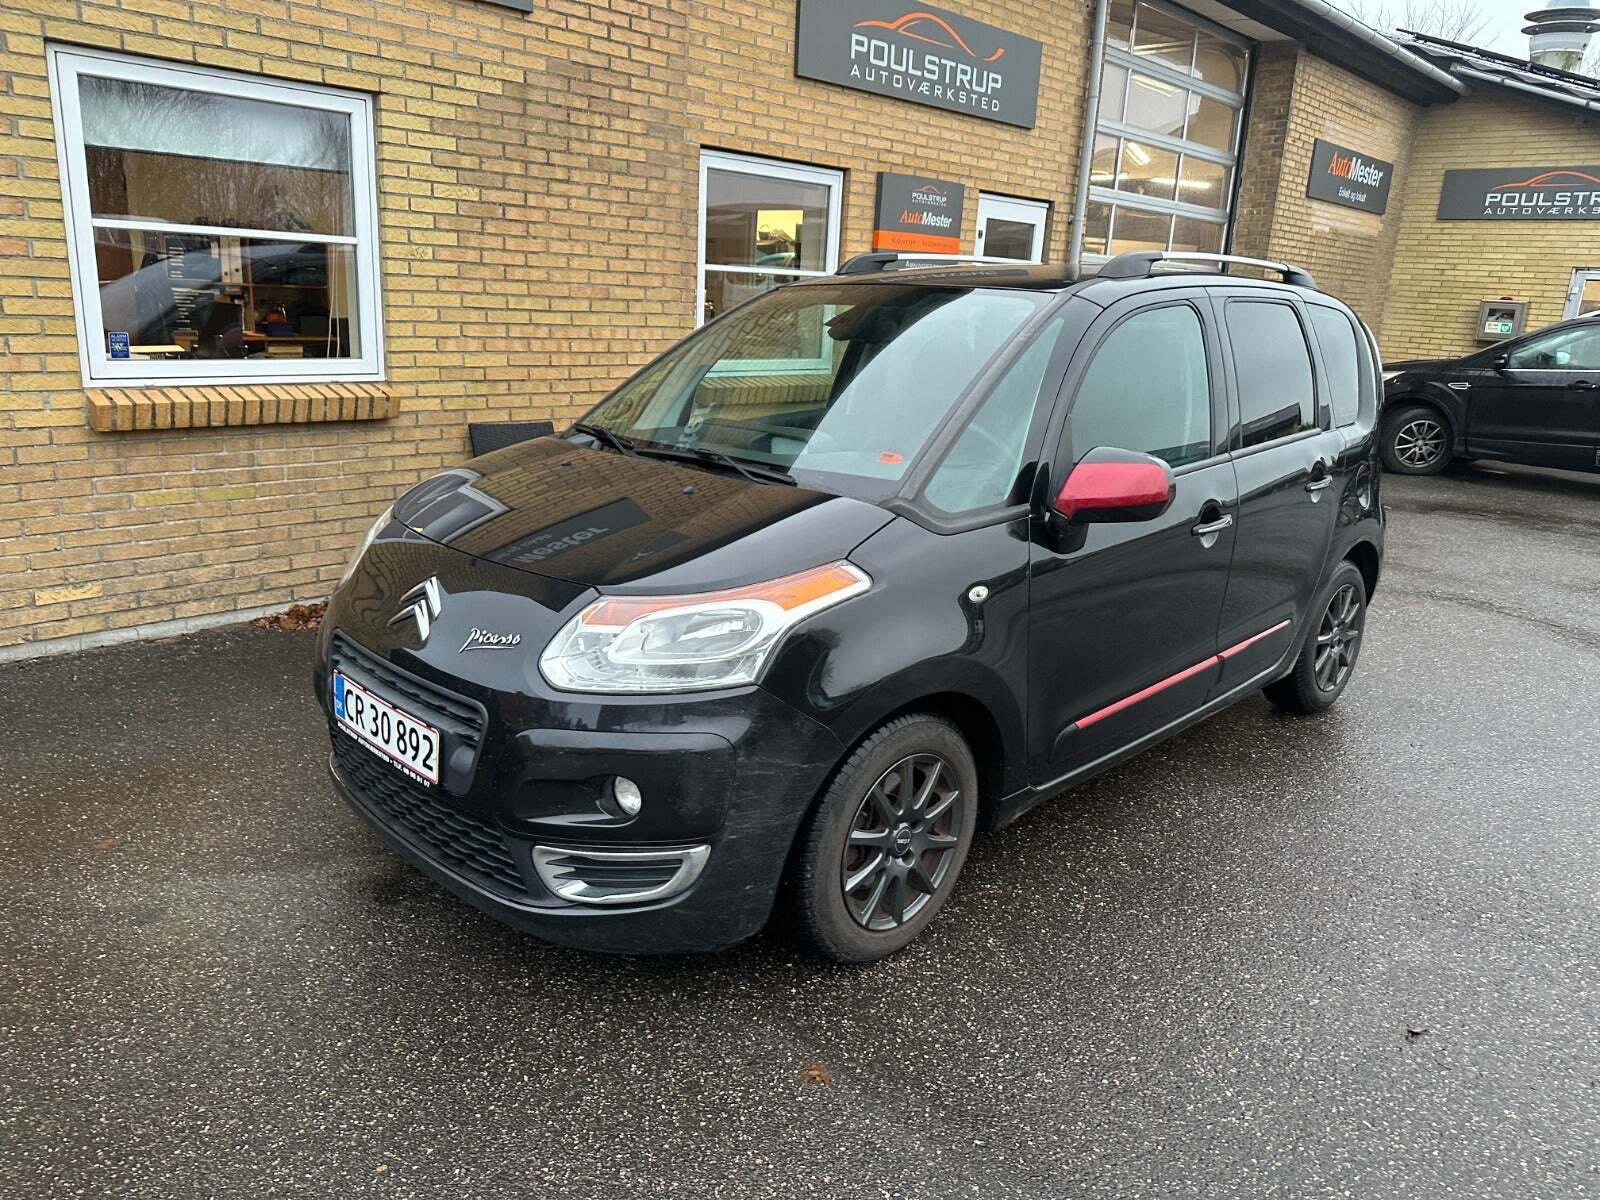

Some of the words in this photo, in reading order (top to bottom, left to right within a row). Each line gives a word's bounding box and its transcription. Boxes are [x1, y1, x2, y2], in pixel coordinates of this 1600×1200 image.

[851, 33, 1001, 94] POULSTRUP
[850, 64, 1000, 112] AUTOVÆRKSTED
[1328, 151, 1383, 187] AutoMester
[900, 209, 952, 228] AutoMester
[458, 627, 522, 654] Picasso
[345, 689, 365, 729] CR
[369, 704, 392, 745] 30
[396, 719, 435, 773] 892
